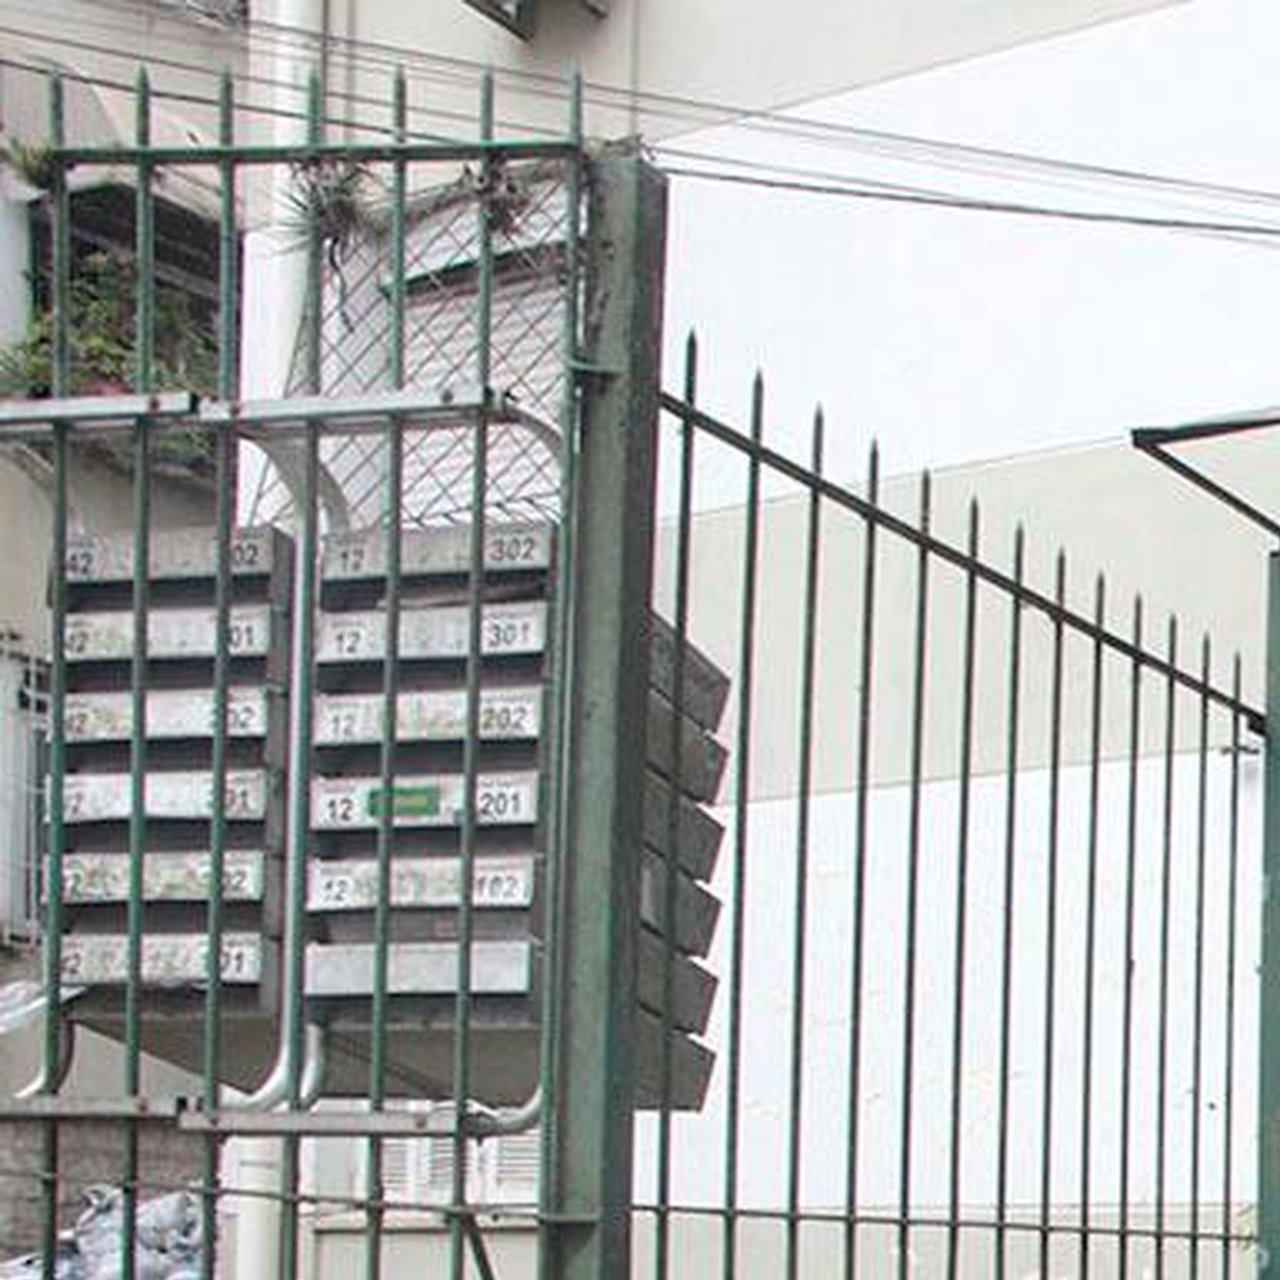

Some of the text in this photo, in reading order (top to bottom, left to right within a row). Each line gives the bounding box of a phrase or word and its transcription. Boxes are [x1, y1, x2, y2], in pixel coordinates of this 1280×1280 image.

[341, 537, 536, 571] 12 302
[335, 621, 531, 655] 12 301
[331, 706, 528, 738] 12 202
[327, 798, 354, 821] 12
[479, 792, 521, 817] 201
[323, 875, 519, 902] 12 102
